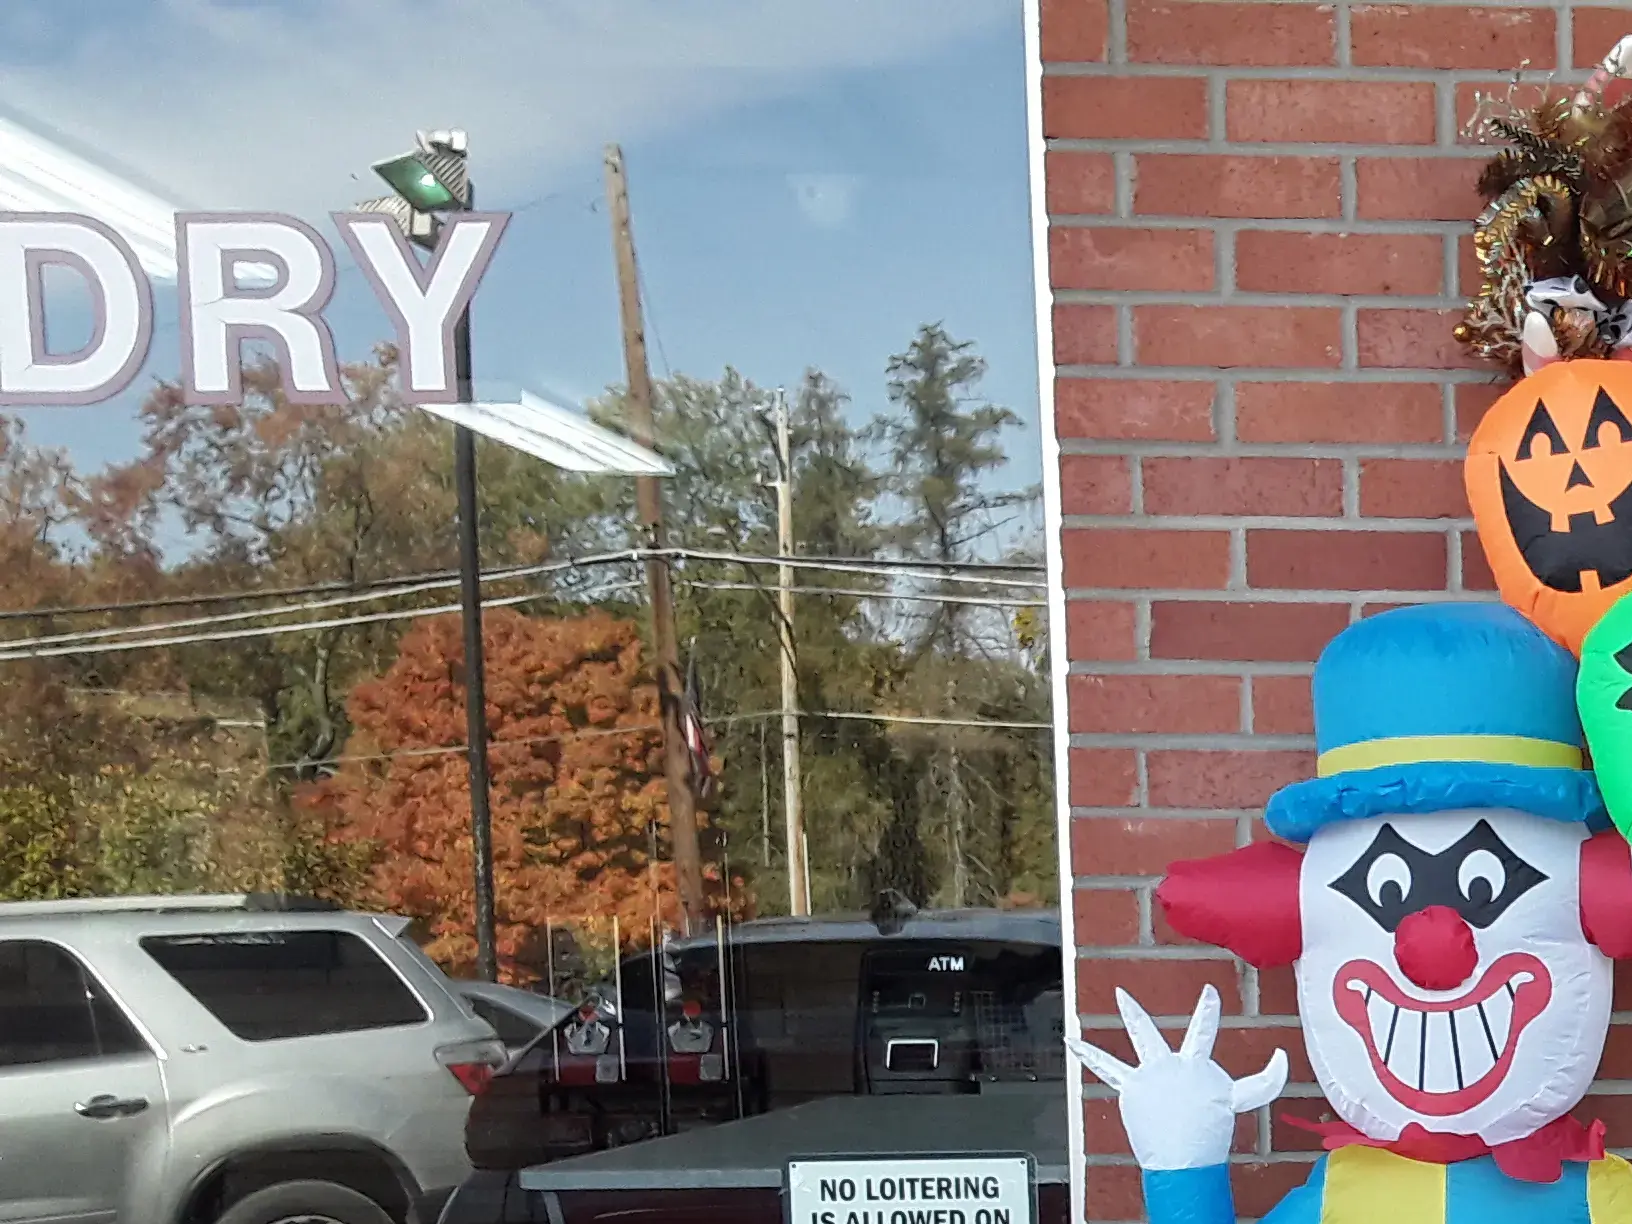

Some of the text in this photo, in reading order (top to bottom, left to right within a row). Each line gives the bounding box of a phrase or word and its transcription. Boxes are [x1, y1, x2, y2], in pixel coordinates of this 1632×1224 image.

[0, 210, 513, 405] DRY
[928, 956, 964, 971] ATM
[819, 1176, 1000, 1201] NO LOITERING
